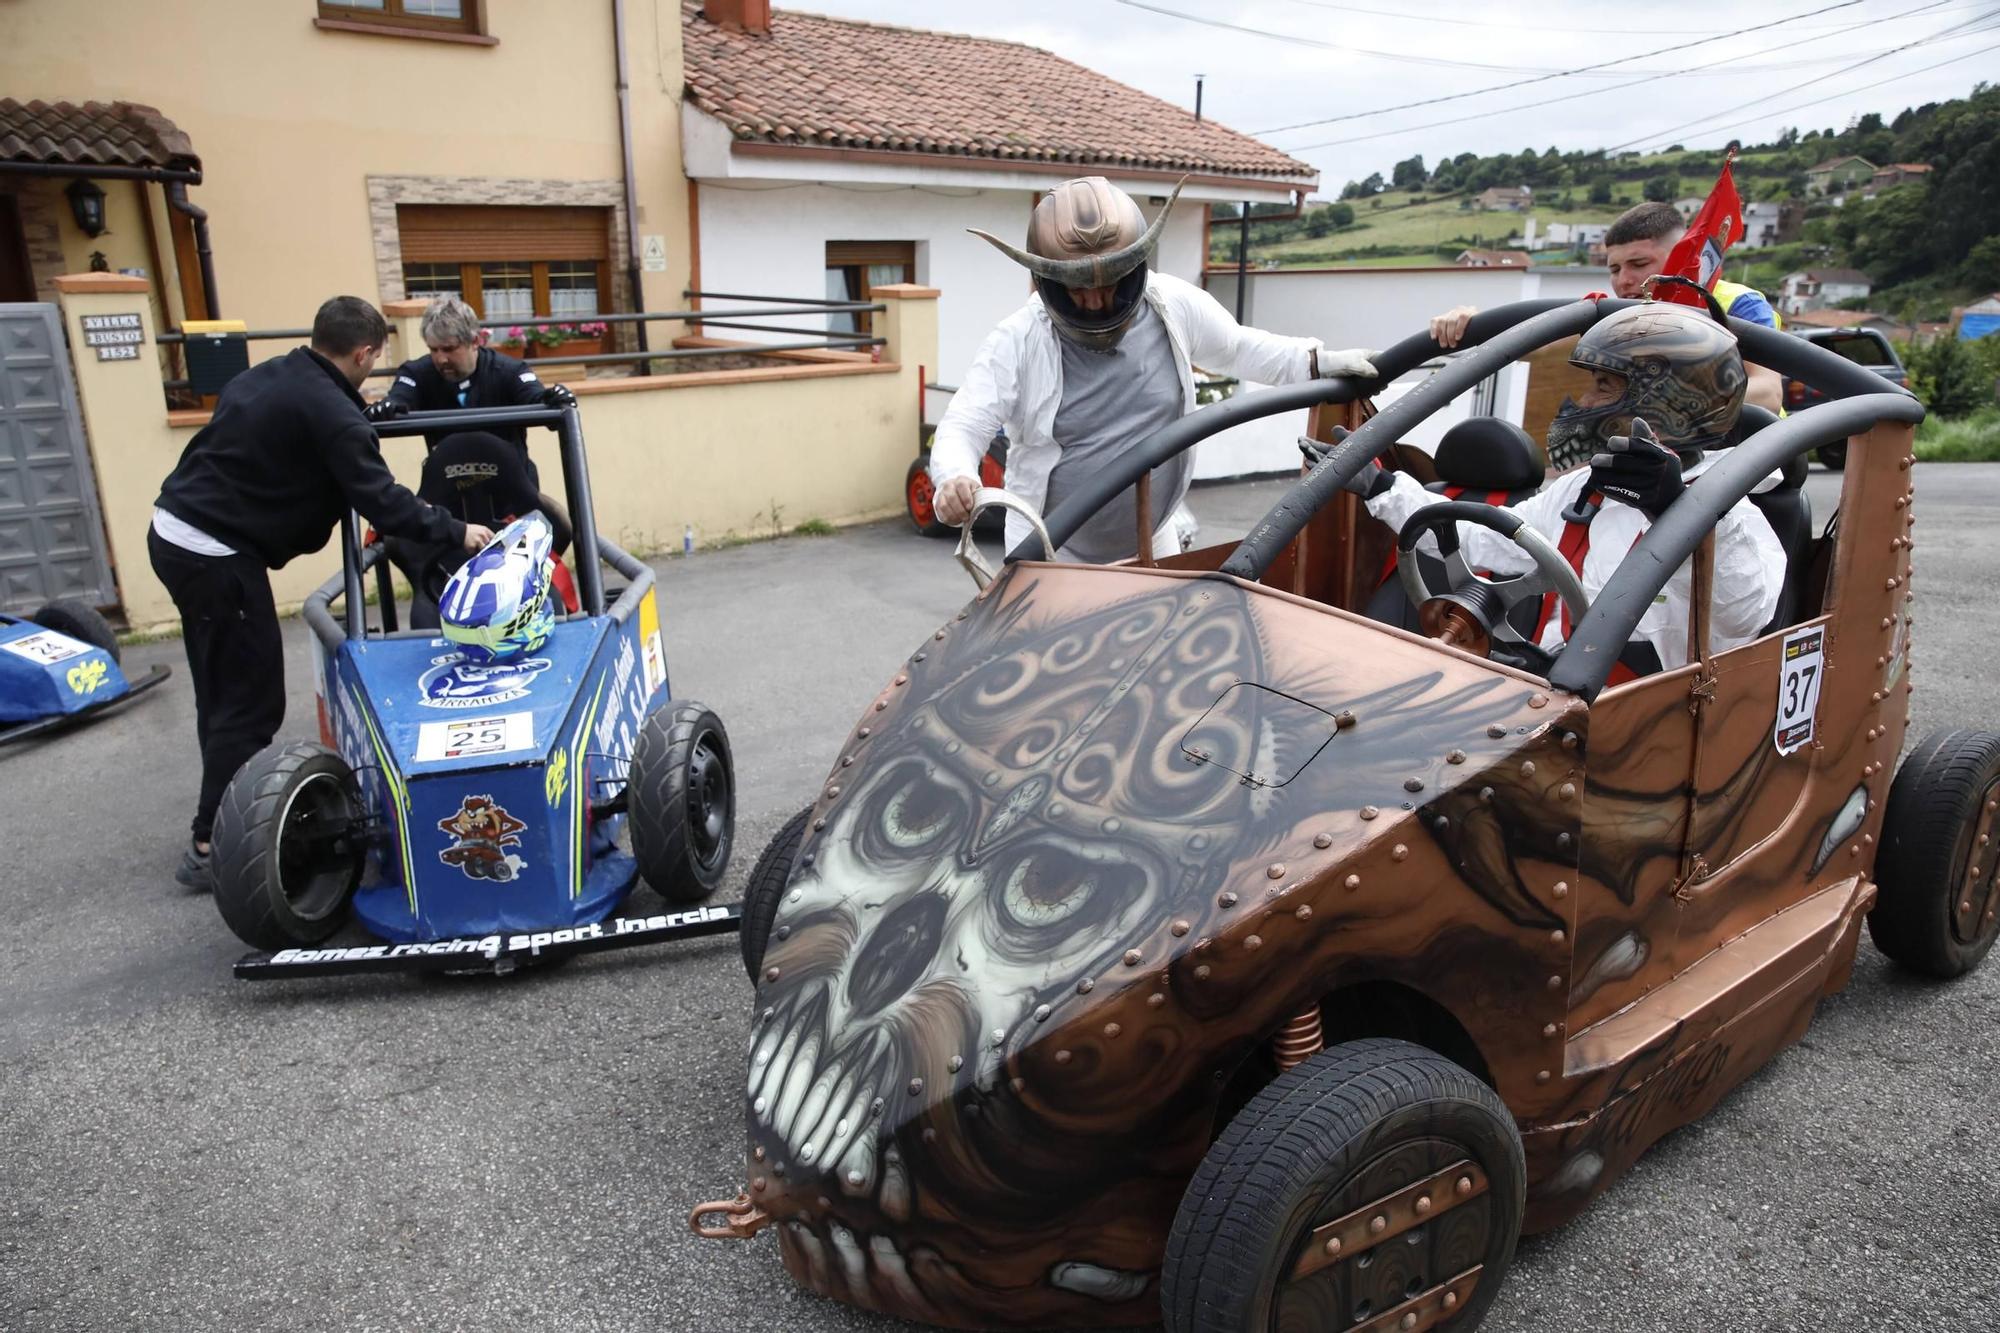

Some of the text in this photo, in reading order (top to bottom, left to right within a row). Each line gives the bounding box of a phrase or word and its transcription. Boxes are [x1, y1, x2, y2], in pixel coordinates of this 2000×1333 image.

[30, 641, 64, 656] 24
[1783, 664, 1818, 719] 37
[451, 728, 503, 748] 25
[270, 905, 730, 964] Gomez racing sport Inercia
